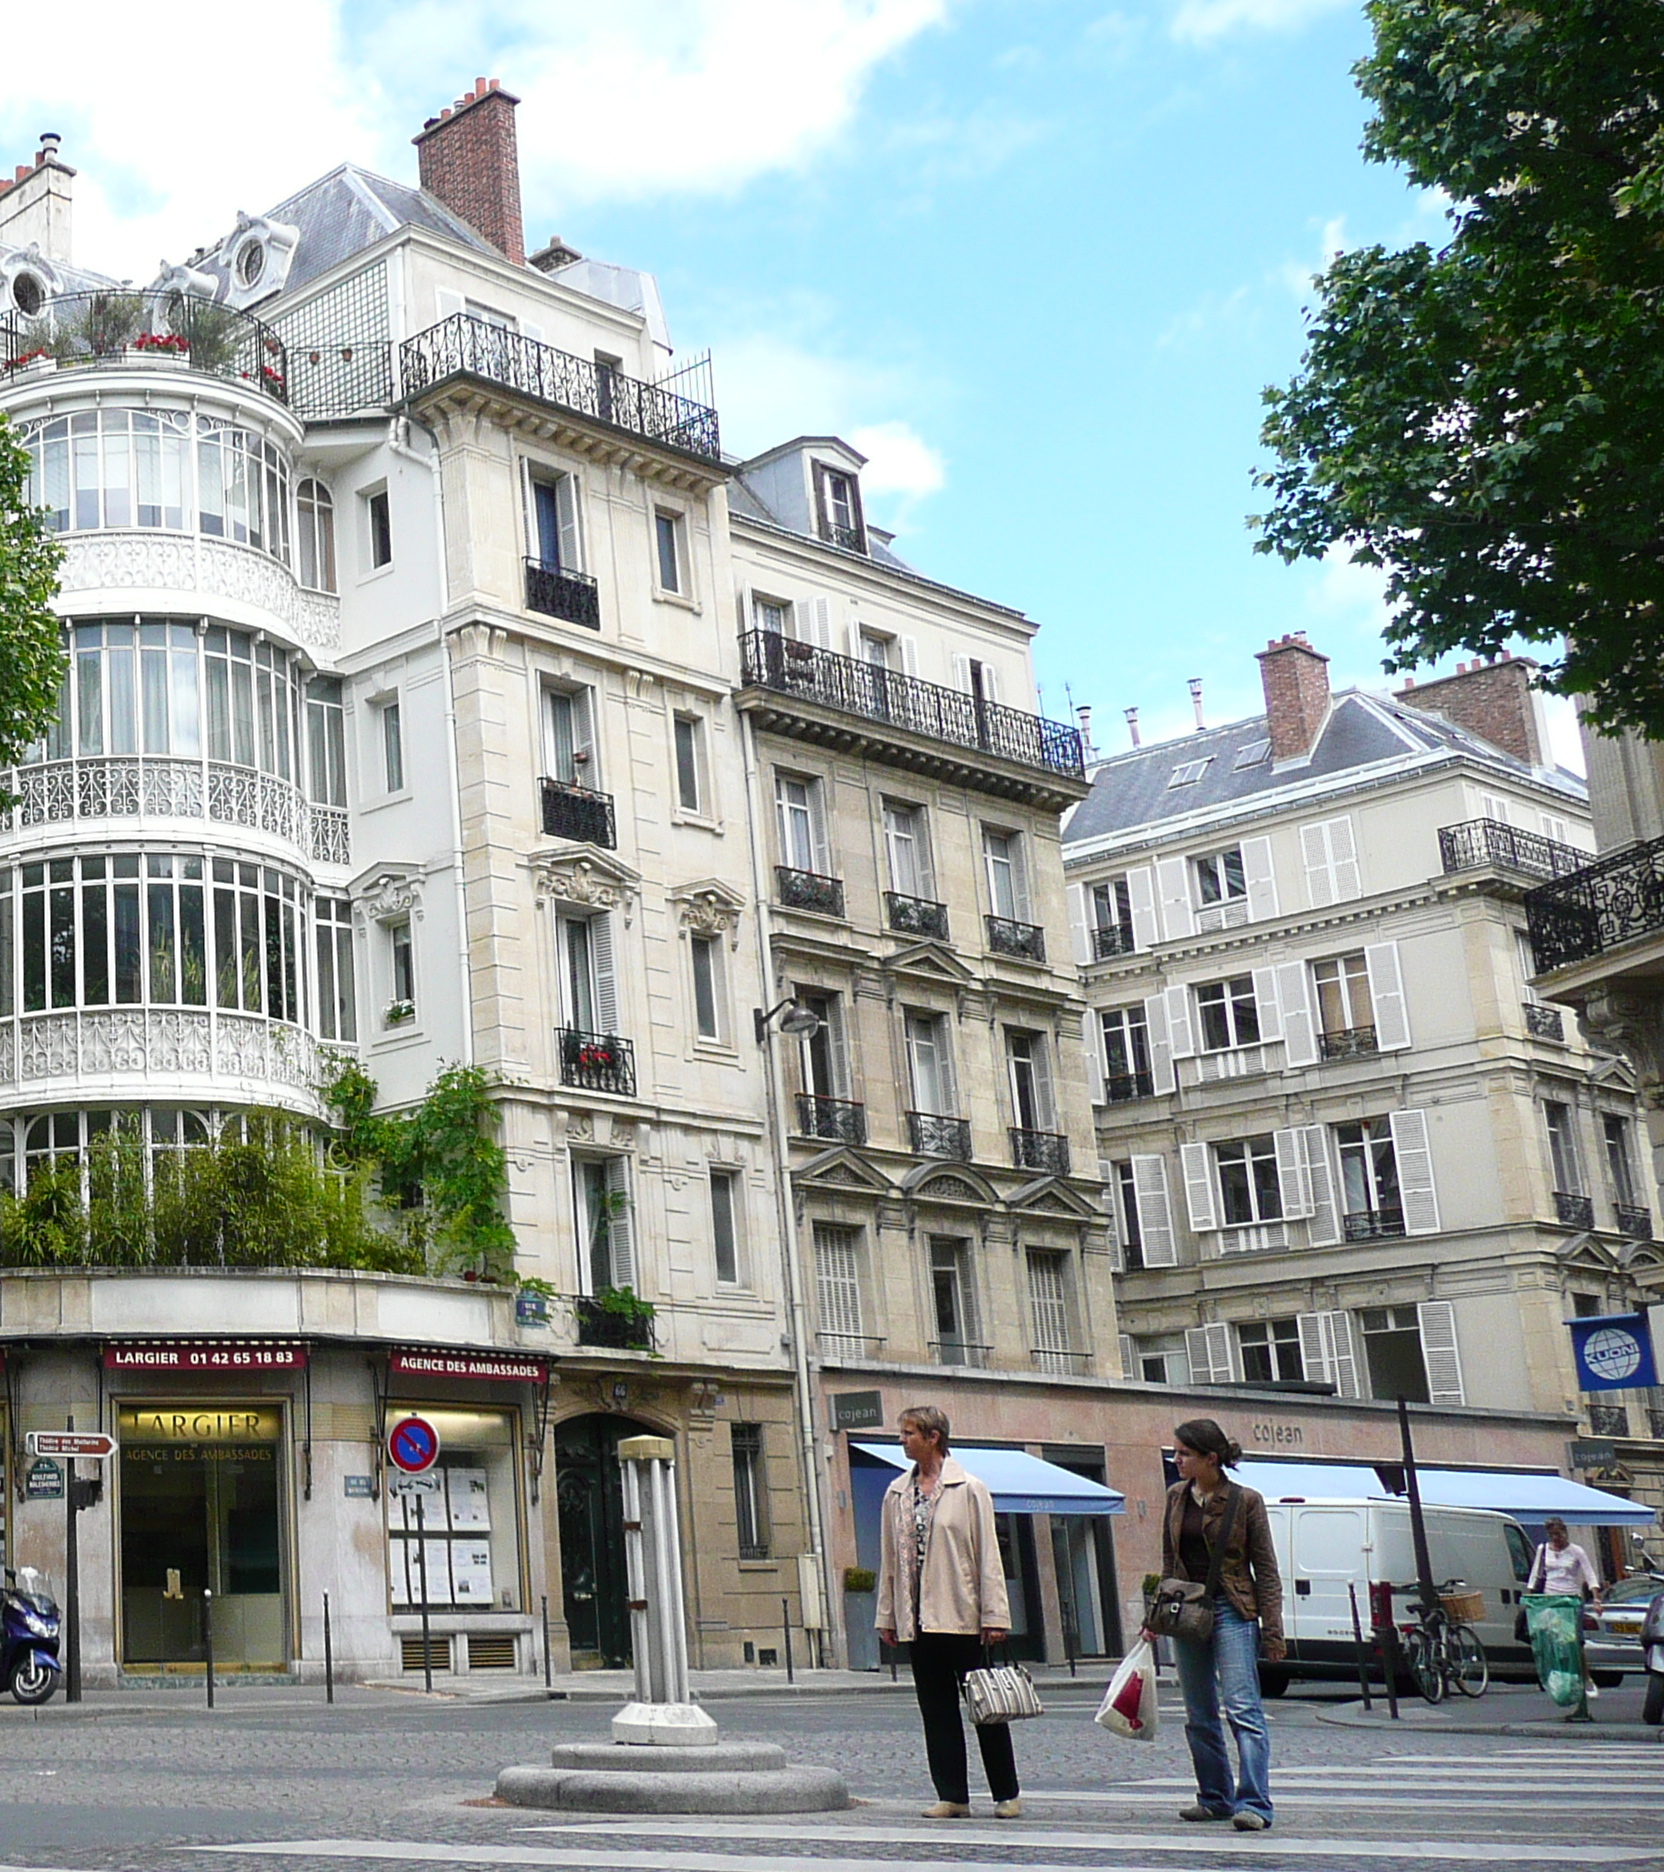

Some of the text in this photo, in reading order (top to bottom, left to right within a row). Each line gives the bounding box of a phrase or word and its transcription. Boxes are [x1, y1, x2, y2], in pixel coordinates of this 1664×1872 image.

[116, 1351, 293, 1364] LARGIER 01 42 65 18 83
[1585, 1343, 1639, 1365] KUONI
[400, 1356, 539, 1377] AGENCE DES AMBASSADES
[838, 1406, 877, 1422] cojean
[134, 1414, 261, 1438] LARGIER
[1253, 1418, 1303, 1449] cojean
[126, 1449, 272, 1461] AGENCE DES AMBASSADES
